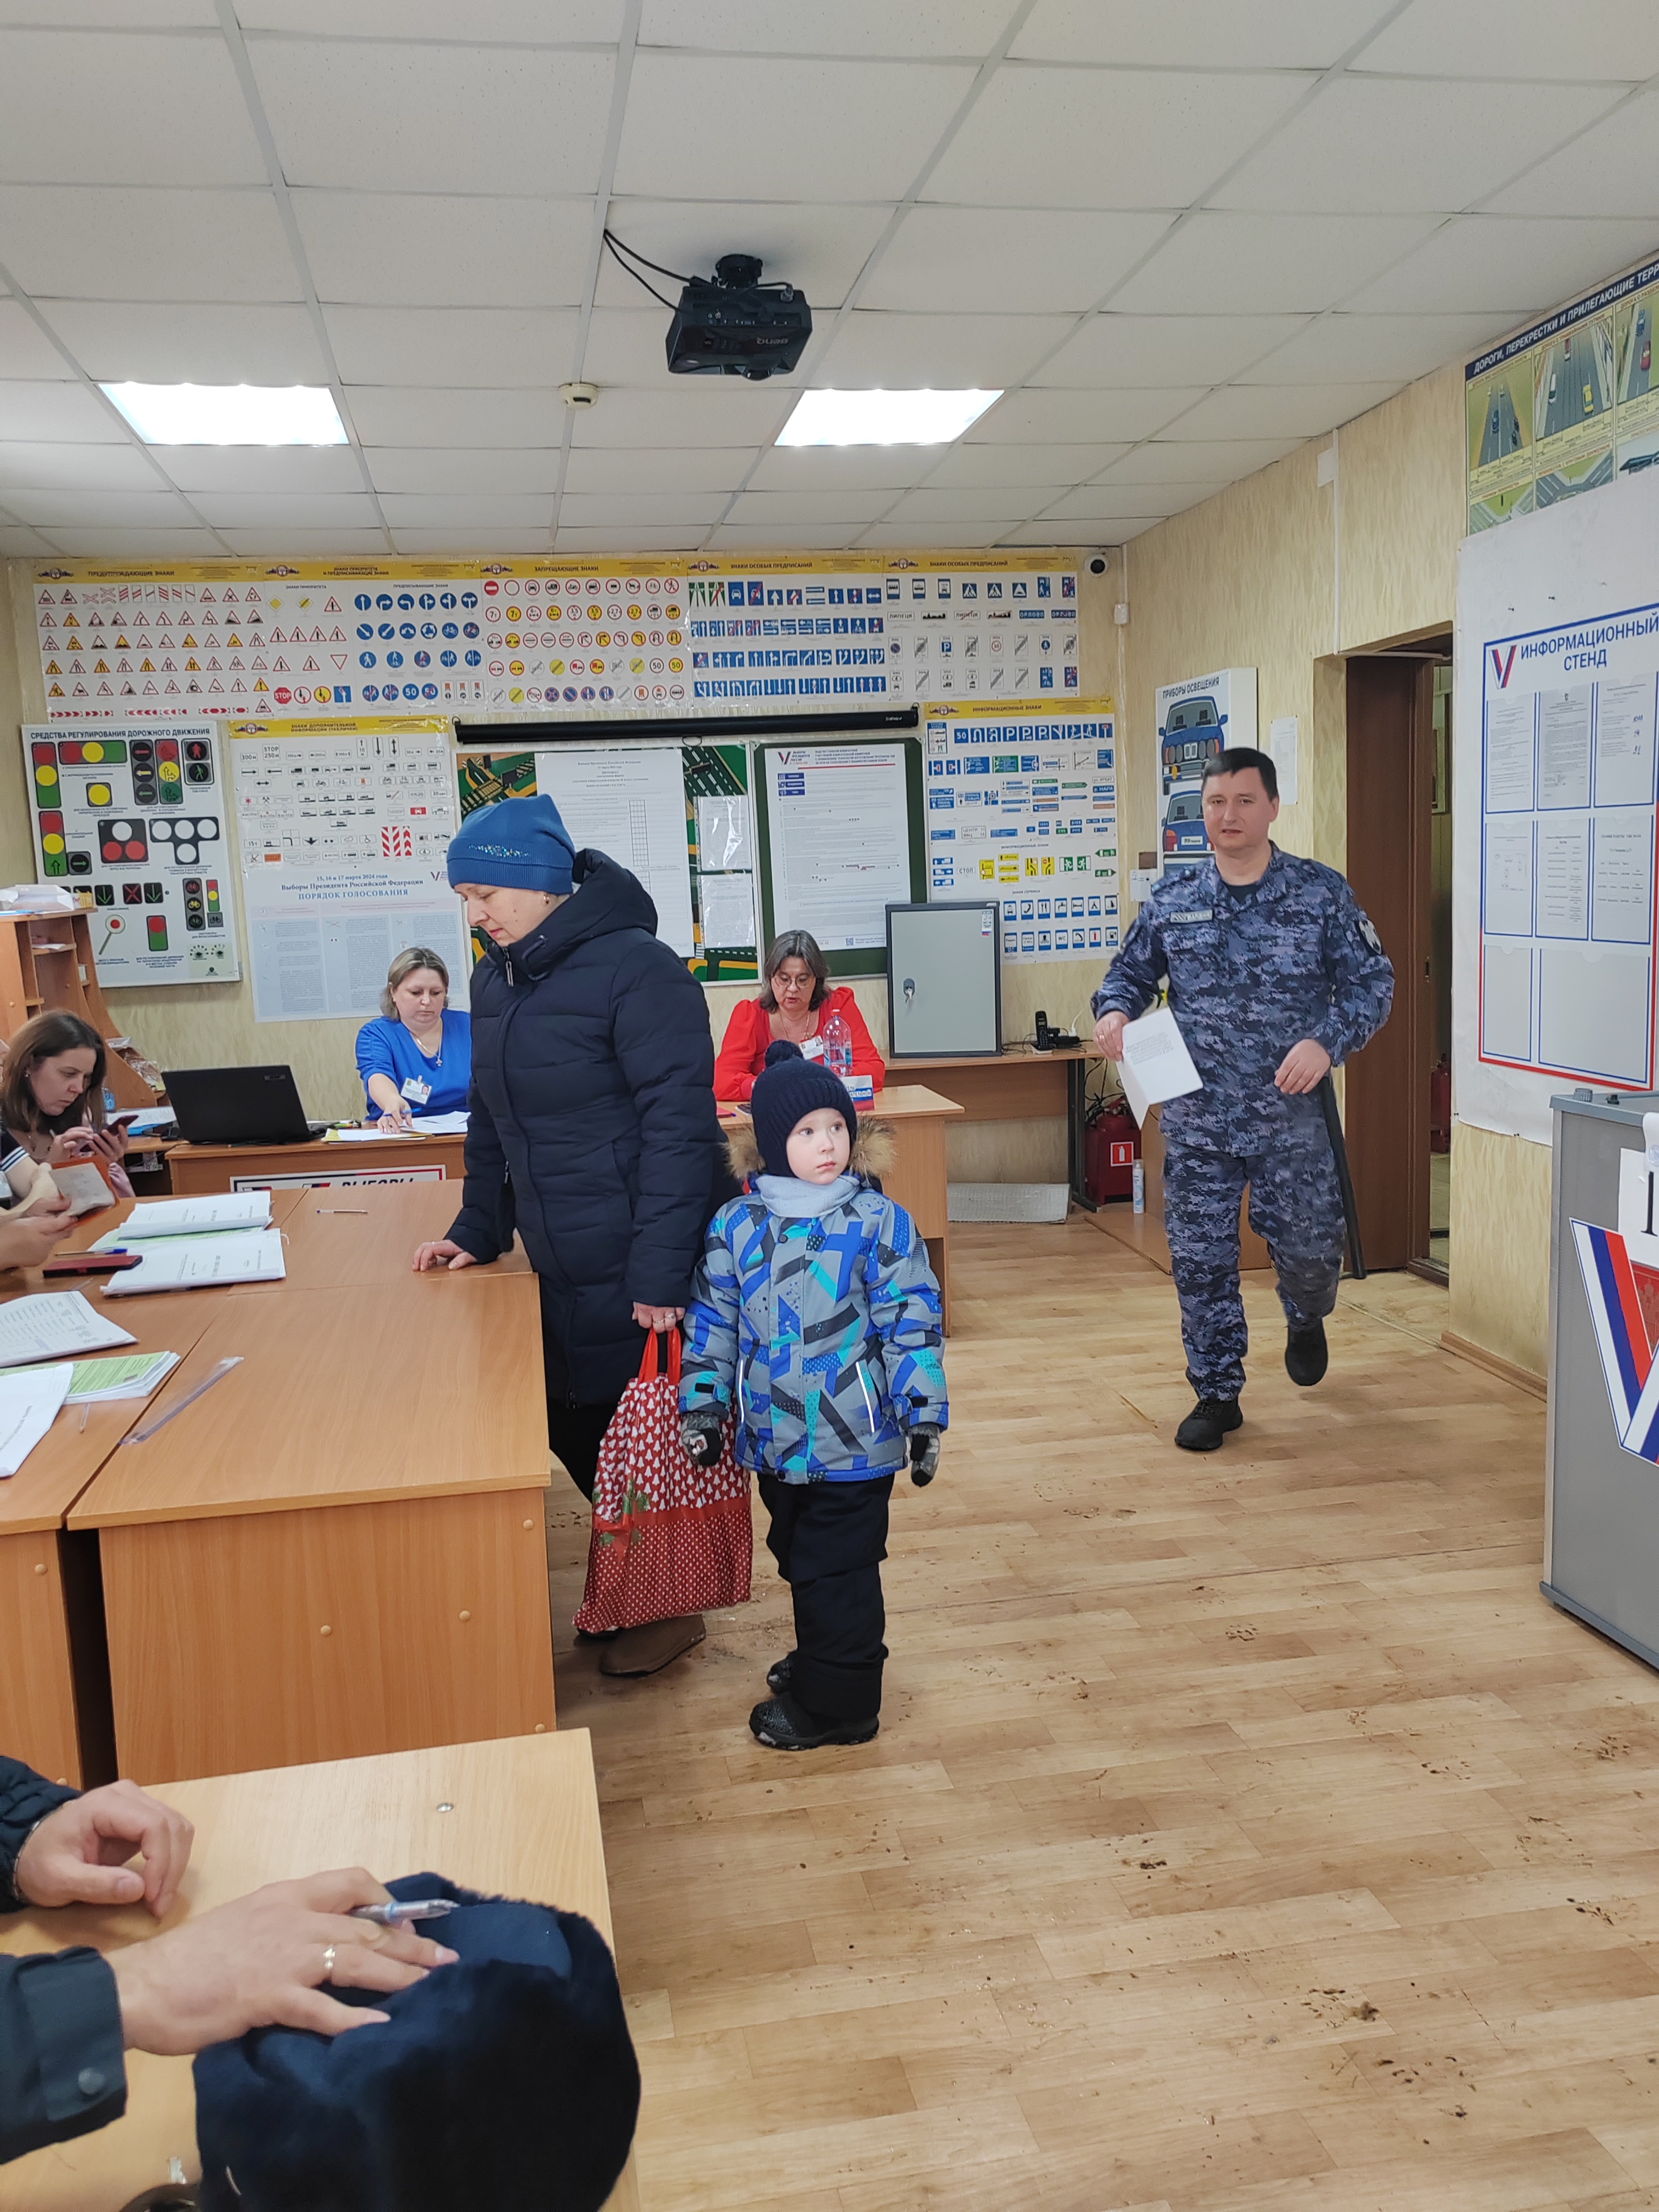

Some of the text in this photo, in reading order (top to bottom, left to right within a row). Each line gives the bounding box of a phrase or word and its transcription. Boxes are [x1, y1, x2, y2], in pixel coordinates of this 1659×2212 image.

[1474, 351, 1505, 375] ДОРОГИ,
[1506, 319, 1558, 355] ПЕРЕКРЕСТКИ
[1560, 313, 1566, 326] И
[1567, 276, 1635, 322] ПРИЛЕГАЮЩИЕ
[1521, 611, 1659, 660] ИНФОРМАЦИОННЫЙ
[1564, 649, 1607, 671] СТЕНД
[1162, 677, 1219, 699] ПРИБОРЫ ОСВЕЩЕНИЯ
[31, 728, 210, 740] СРЕДСТВА РЕГУЛИРОВАНИЯ ДОРОЖНОГО ДВИЖЕНИЯ
[298, 889, 408, 900] ПОРЯДОК ГОЛОСОВАНИЯ
[310, 882, 348, 891] Президента
